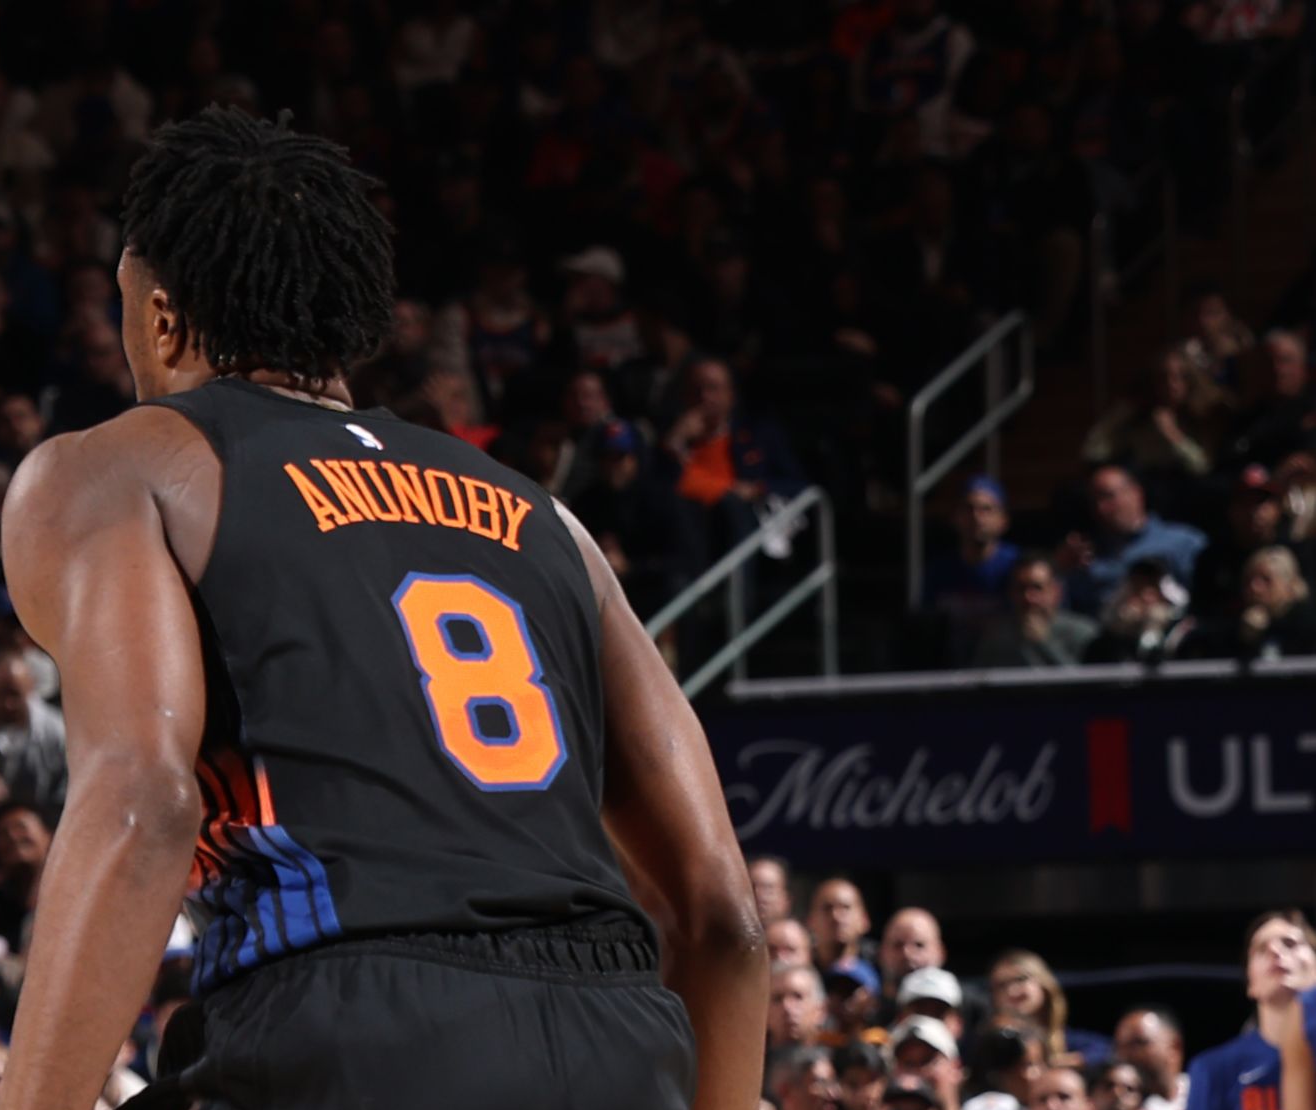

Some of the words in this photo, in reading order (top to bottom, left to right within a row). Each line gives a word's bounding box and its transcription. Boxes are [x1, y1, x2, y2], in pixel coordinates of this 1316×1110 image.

[284, 459, 532, 551] ANUNOBY
[390, 571, 569, 793] 8
[724, 738, 1059, 841] Michelob
[1167, 734, 1316, 818] UL
